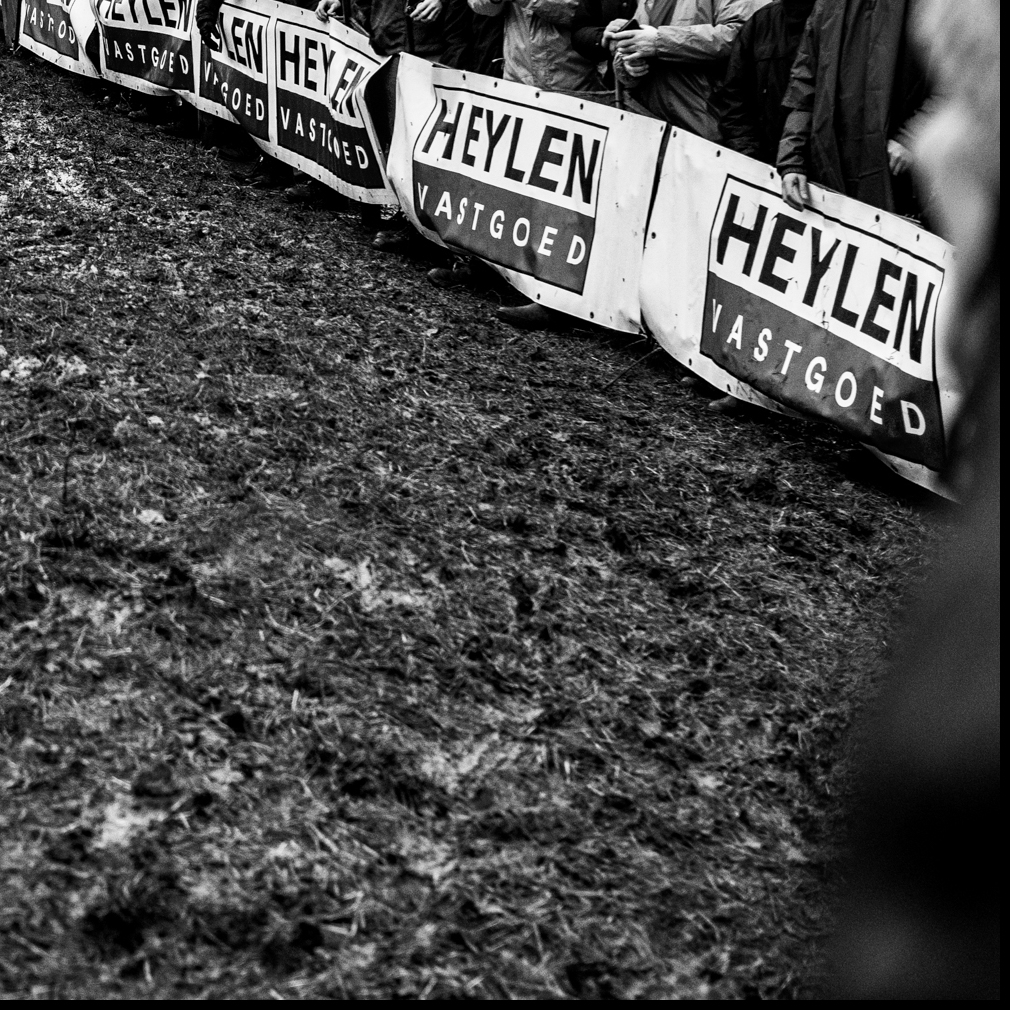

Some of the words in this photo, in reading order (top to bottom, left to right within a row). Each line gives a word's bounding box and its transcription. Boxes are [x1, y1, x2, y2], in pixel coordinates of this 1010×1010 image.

[422, 99, 601, 206] HEYLEN
[416, 182, 587, 267] VASTGOED
[715, 192, 936, 365] HEYLEN
[710, 297, 927, 437] VASTGOED
